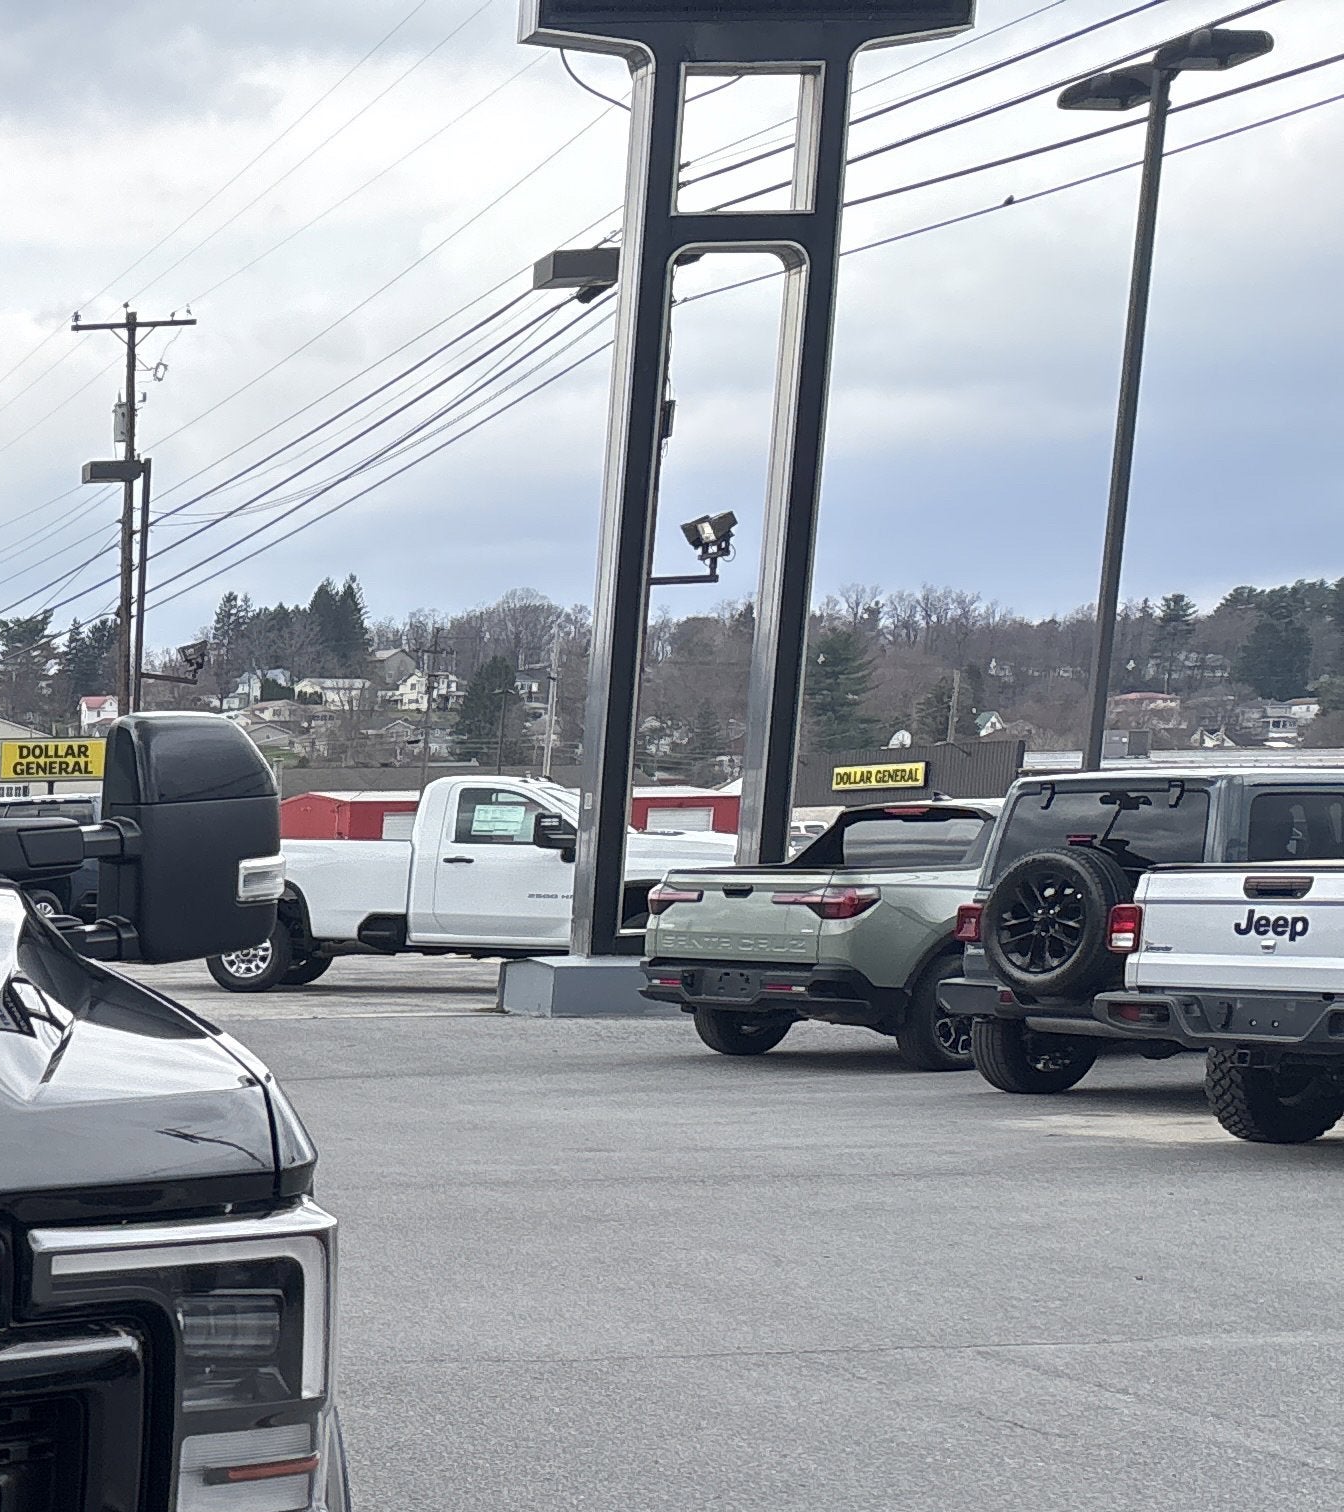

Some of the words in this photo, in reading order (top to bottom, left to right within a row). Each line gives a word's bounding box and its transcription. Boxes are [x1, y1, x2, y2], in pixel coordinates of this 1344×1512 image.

[17, 744, 89, 759] DOLLAR
[12, 760, 93, 775] GENERAL
[835, 770, 872, 785] DOLLAR
[874, 767, 920, 783] GENERAL
[1233, 908, 1310, 942] Jeep
[663, 934, 733, 950] SANTA
[738, 937, 808, 953] CRUZ
